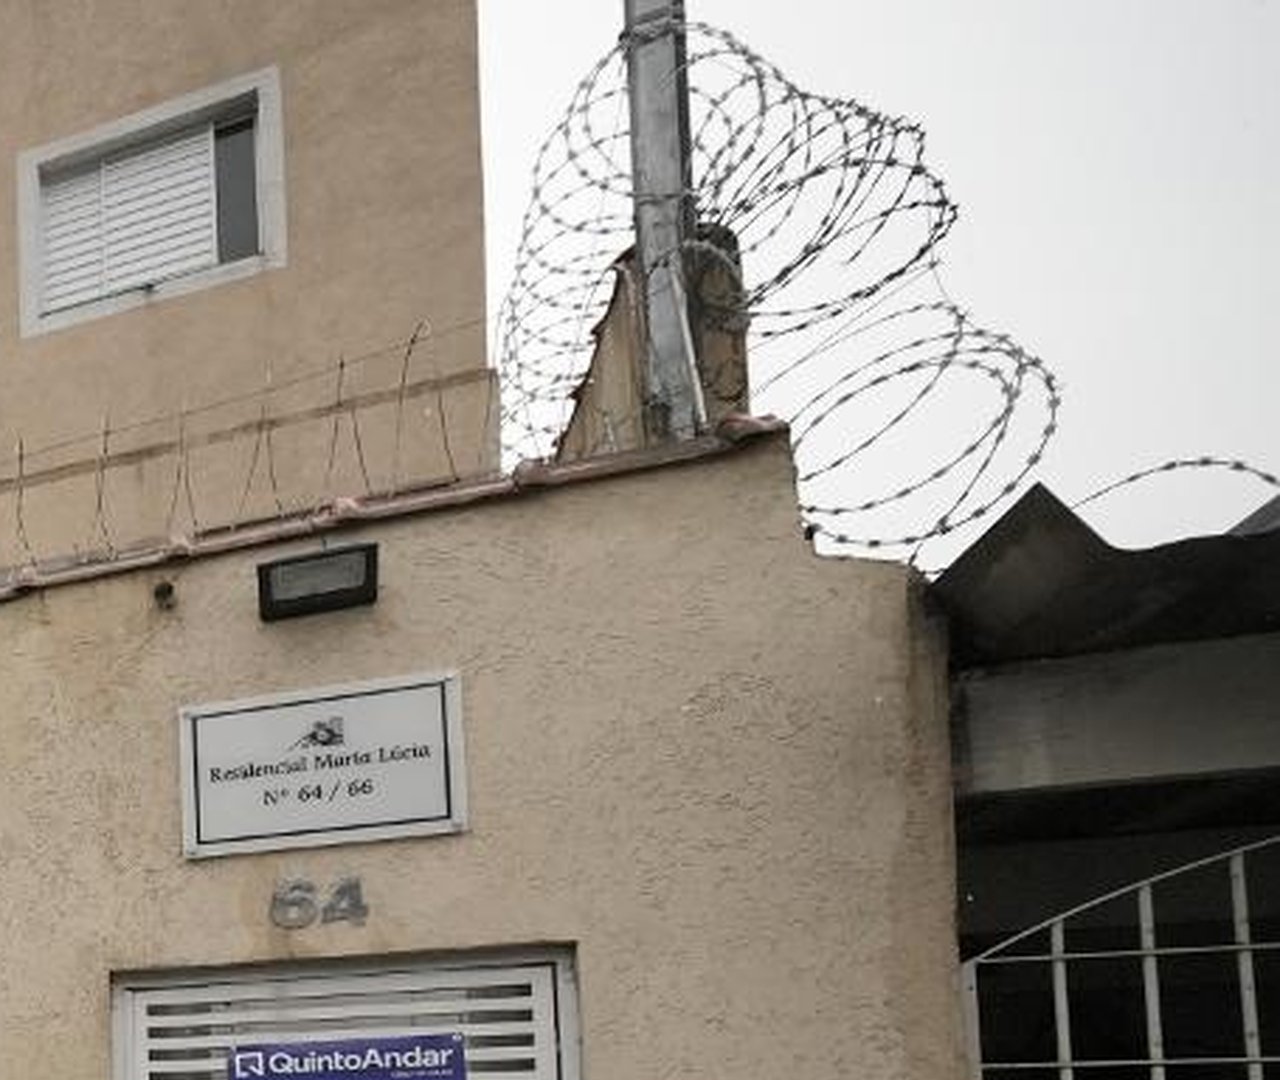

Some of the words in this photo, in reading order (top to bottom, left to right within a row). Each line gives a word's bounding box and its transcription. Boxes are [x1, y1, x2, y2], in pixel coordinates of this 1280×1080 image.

[209, 756, 307, 783] Residencial
[314, 750, 371, 770] Maria
[378, 742, 431, 763] Lúcia
[297, 784, 322, 803] 64
[328, 779, 341, 801] /
[347, 778, 374, 797] 66
[268, 873, 369, 929] 64
[269, 1046, 454, 1074] QuintoAndar
